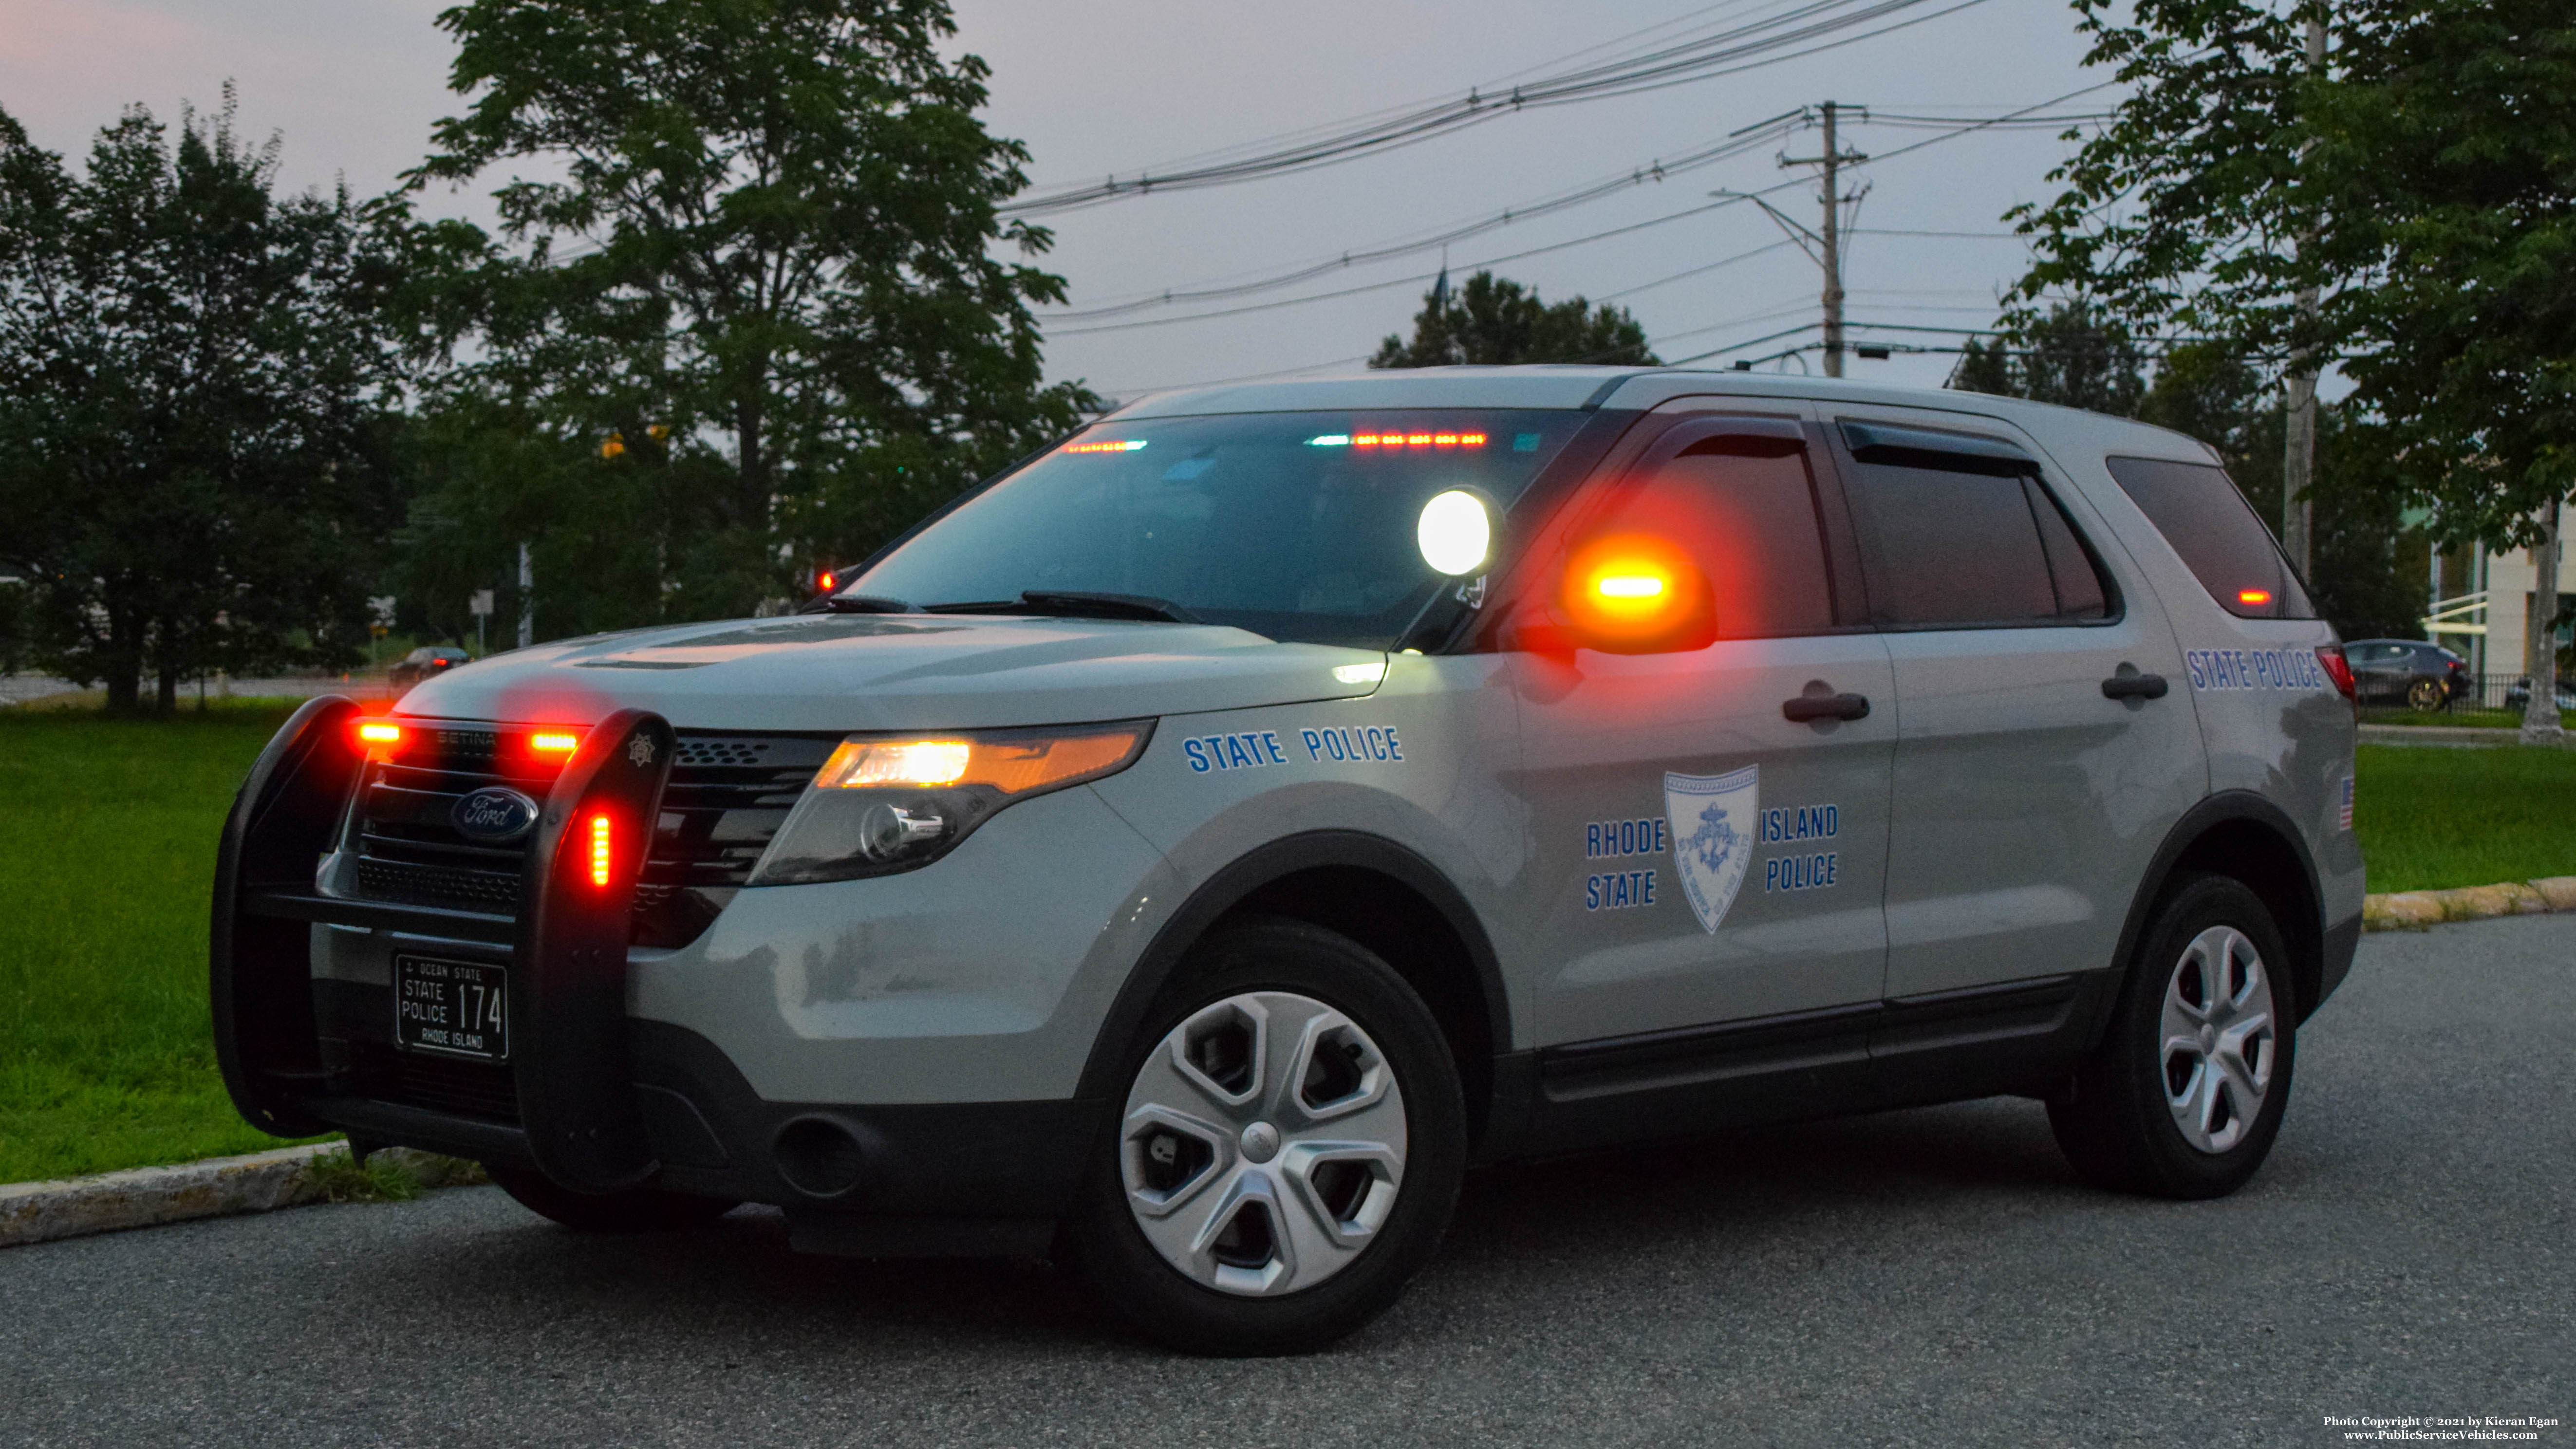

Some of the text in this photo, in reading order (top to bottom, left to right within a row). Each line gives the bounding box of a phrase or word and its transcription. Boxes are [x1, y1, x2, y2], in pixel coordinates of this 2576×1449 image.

[2186, 650, 2321, 689] STATE POLICE
[437, 731, 497, 745] SETINA
[1183, 726, 1404, 773] STATE POLICE
[465, 795, 514, 826] Ford
[1587, 805, 1838, 858] RHODE ISLAND
[1587, 870, 1655, 910] STATE
[1766, 854, 1836, 892] POLICE
[420, 963, 482, 981] OCEAN STATE
[405, 979, 444, 1001] STATE
[402, 1000, 448, 1023] POLICE
[459, 983, 501, 1034] 174
[422, 1027, 483, 1049] RHODE ISLAND
